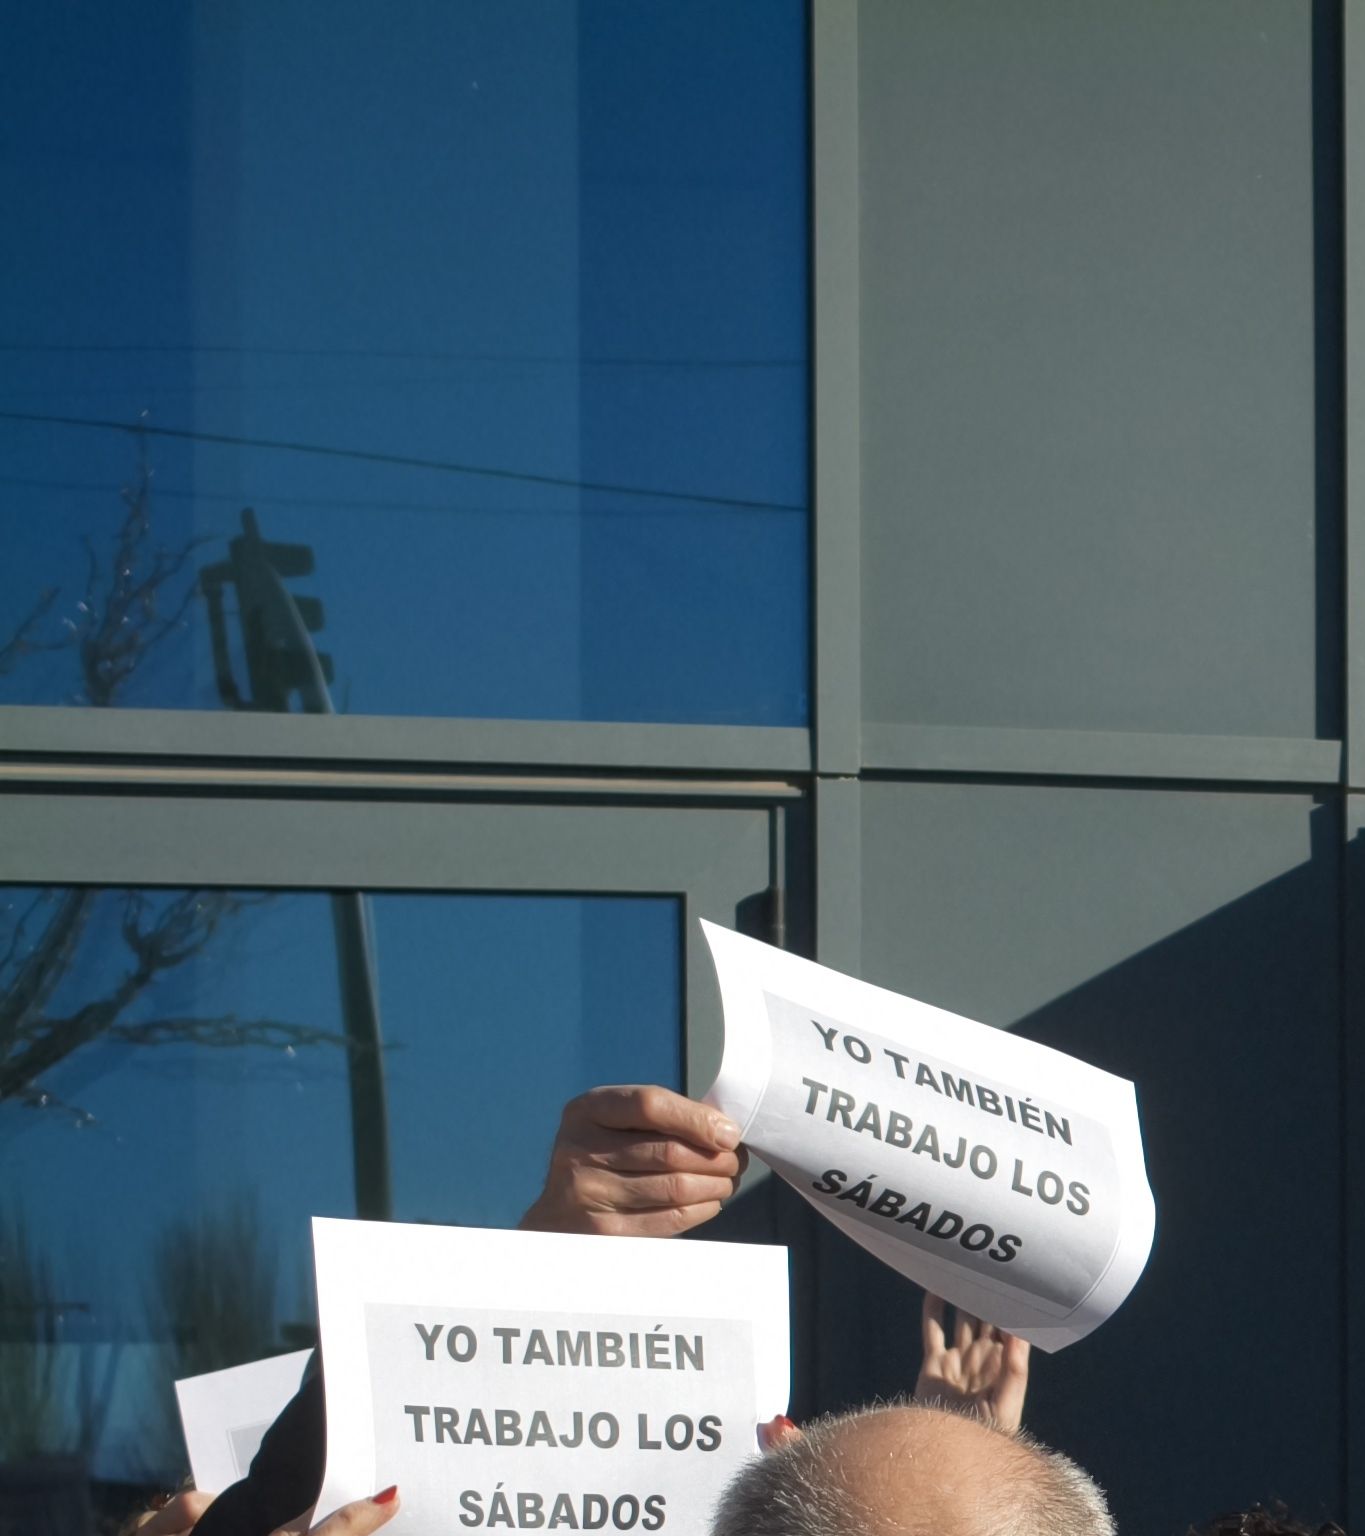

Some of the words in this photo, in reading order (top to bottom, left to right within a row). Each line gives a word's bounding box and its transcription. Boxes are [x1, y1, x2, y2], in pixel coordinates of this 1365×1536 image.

[812, 1021, 871, 1064] YO
[884, 1048, 1074, 1147] TAMBIÉN
[800, 1077, 999, 1182] TRABAJO
[1012, 1159, 1089, 1216] LOS
[812, 1167, 1024, 1264] SÁBADOS
[415, 1324, 477, 1362] YO
[493, 1324, 704, 1371] TAMBIÉN
[404, 1405, 619, 1449] TRABAJO
[638, 1414, 722, 1451] LOS
[459, 1483, 666, 1531] SÁBADOS
